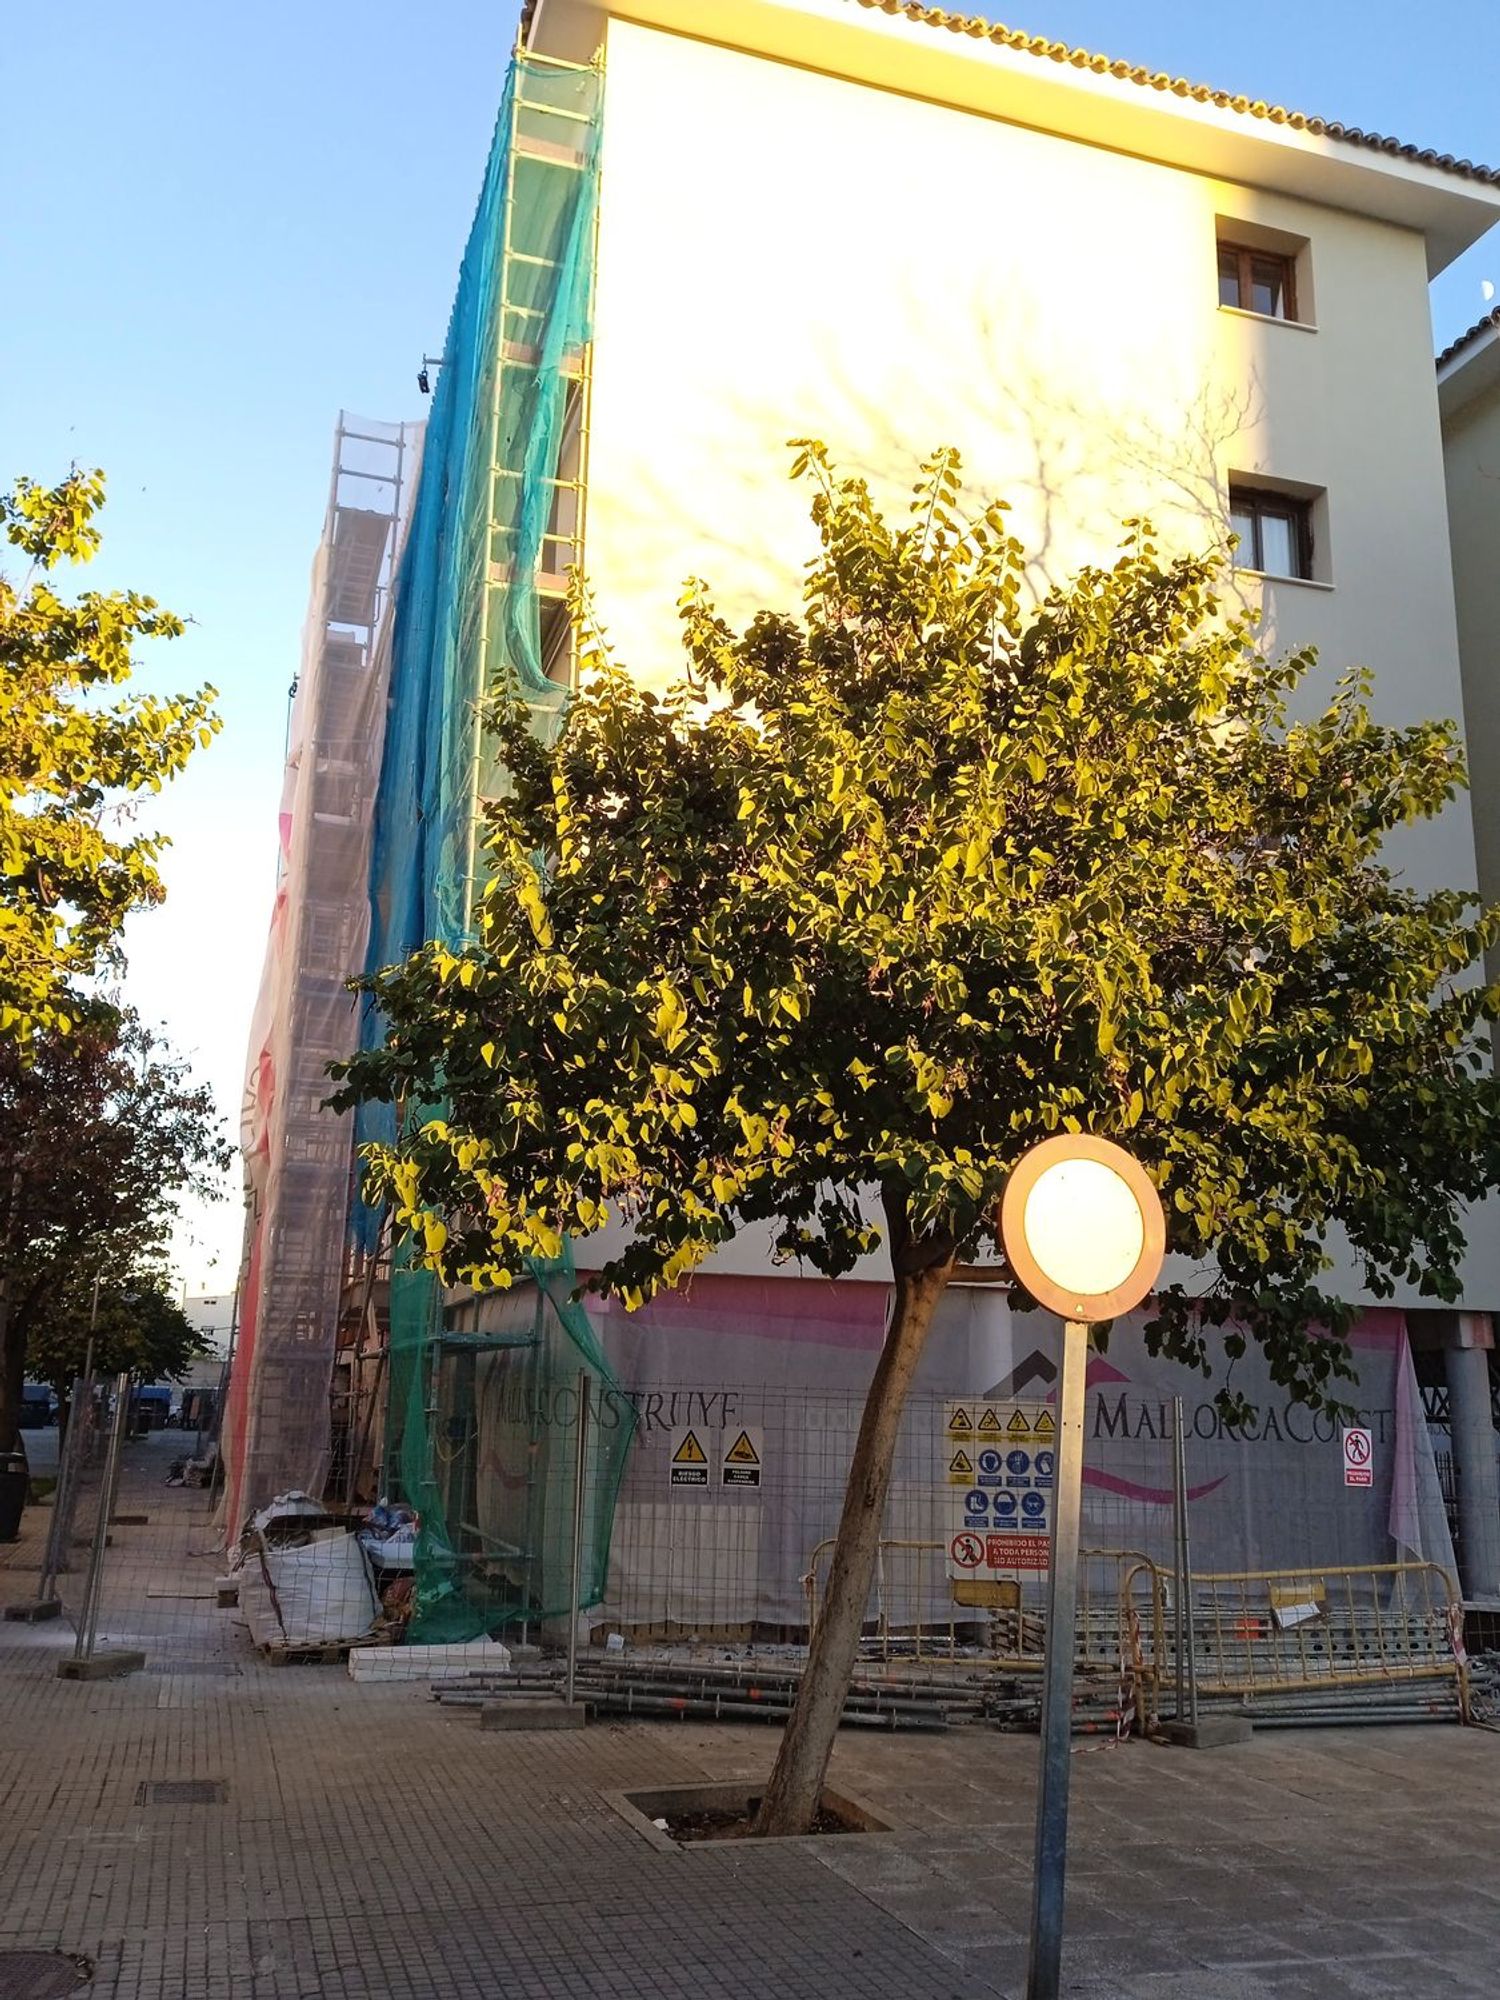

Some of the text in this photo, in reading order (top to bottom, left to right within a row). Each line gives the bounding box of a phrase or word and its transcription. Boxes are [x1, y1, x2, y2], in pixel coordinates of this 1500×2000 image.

[987, 1538, 1027, 1547] PROHIBIDO
[1000, 1548, 1020, 1556] TODA
[1020, 1549, 1050, 1557] PERSON
[1006, 1557, 1048, 1566] AUTORIZAD
